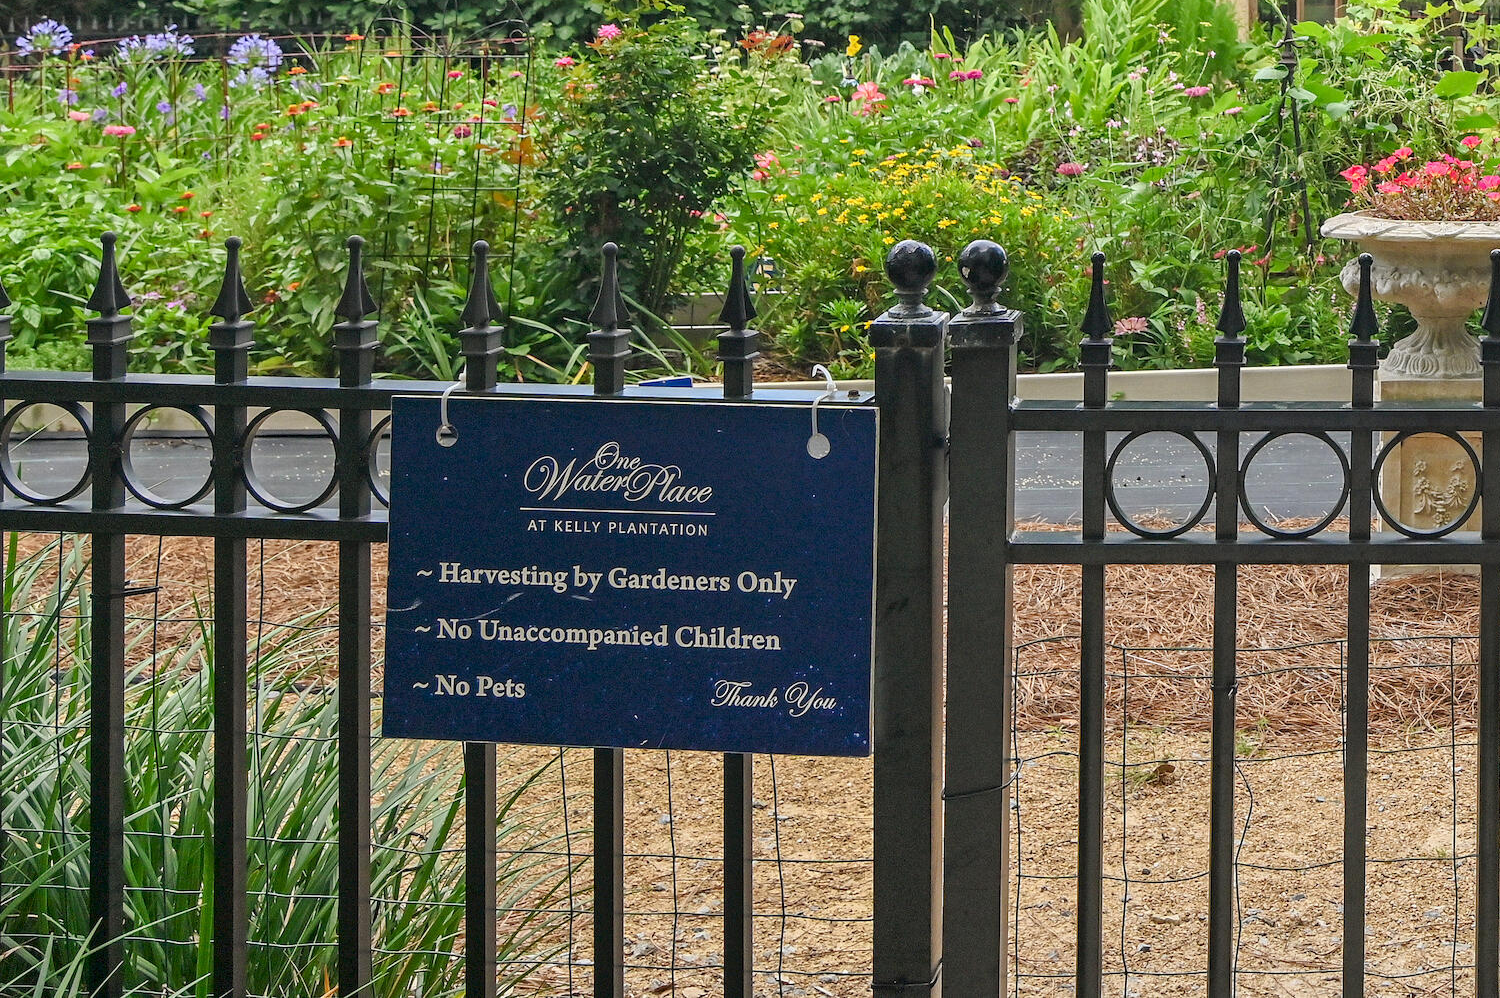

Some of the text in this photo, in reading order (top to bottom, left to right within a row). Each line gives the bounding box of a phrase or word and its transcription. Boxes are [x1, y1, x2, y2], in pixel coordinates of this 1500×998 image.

[595, 441, 641, 470] One
[527, 519, 709, 537] AT KELLY PLANTATION
[439, 562, 568, 593] Harvesting
[573, 566, 602, 594] by
[608, 567, 731, 592] Gardeners
[737, 571, 798, 600] Only
[436, 618, 472, 640] No
[479, 620, 668, 651] Unaccompanied
[675, 627, 782, 651] Children
[434, 674, 470, 697] No
[476, 676, 526, 699] Pets
[710, 679, 837, 718] Thank You
